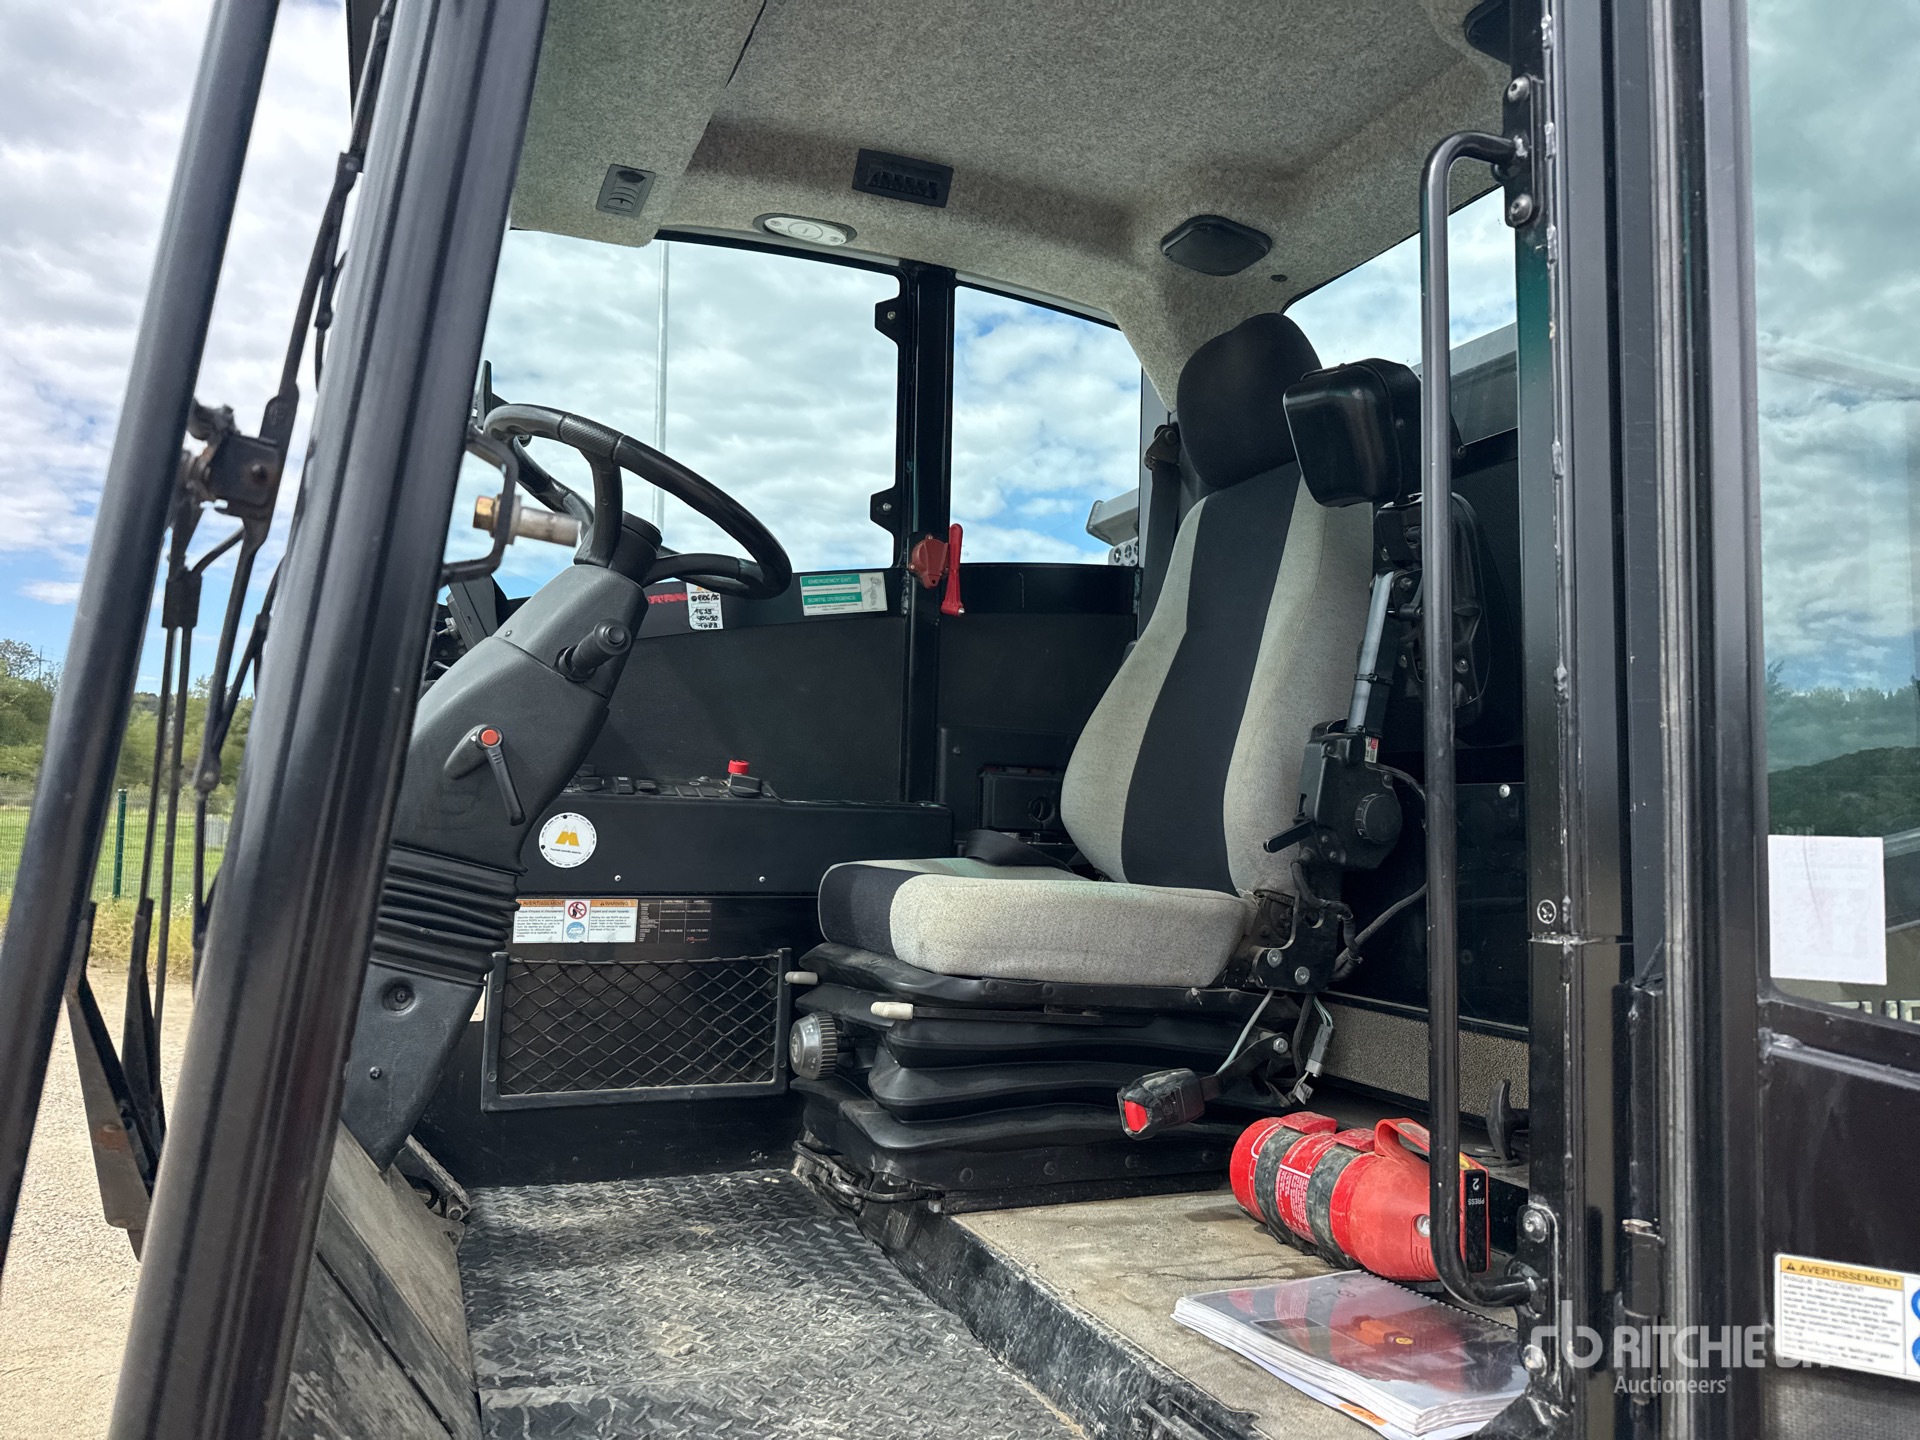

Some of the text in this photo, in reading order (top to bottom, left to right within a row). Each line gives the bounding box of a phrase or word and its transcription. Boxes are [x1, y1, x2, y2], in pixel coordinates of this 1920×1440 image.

[1472, 1177, 1480, 1191] 2
[1467, 1197, 1485, 1206] PRESS
[1800, 1263, 1900, 1287] AVERTISSEMENT
